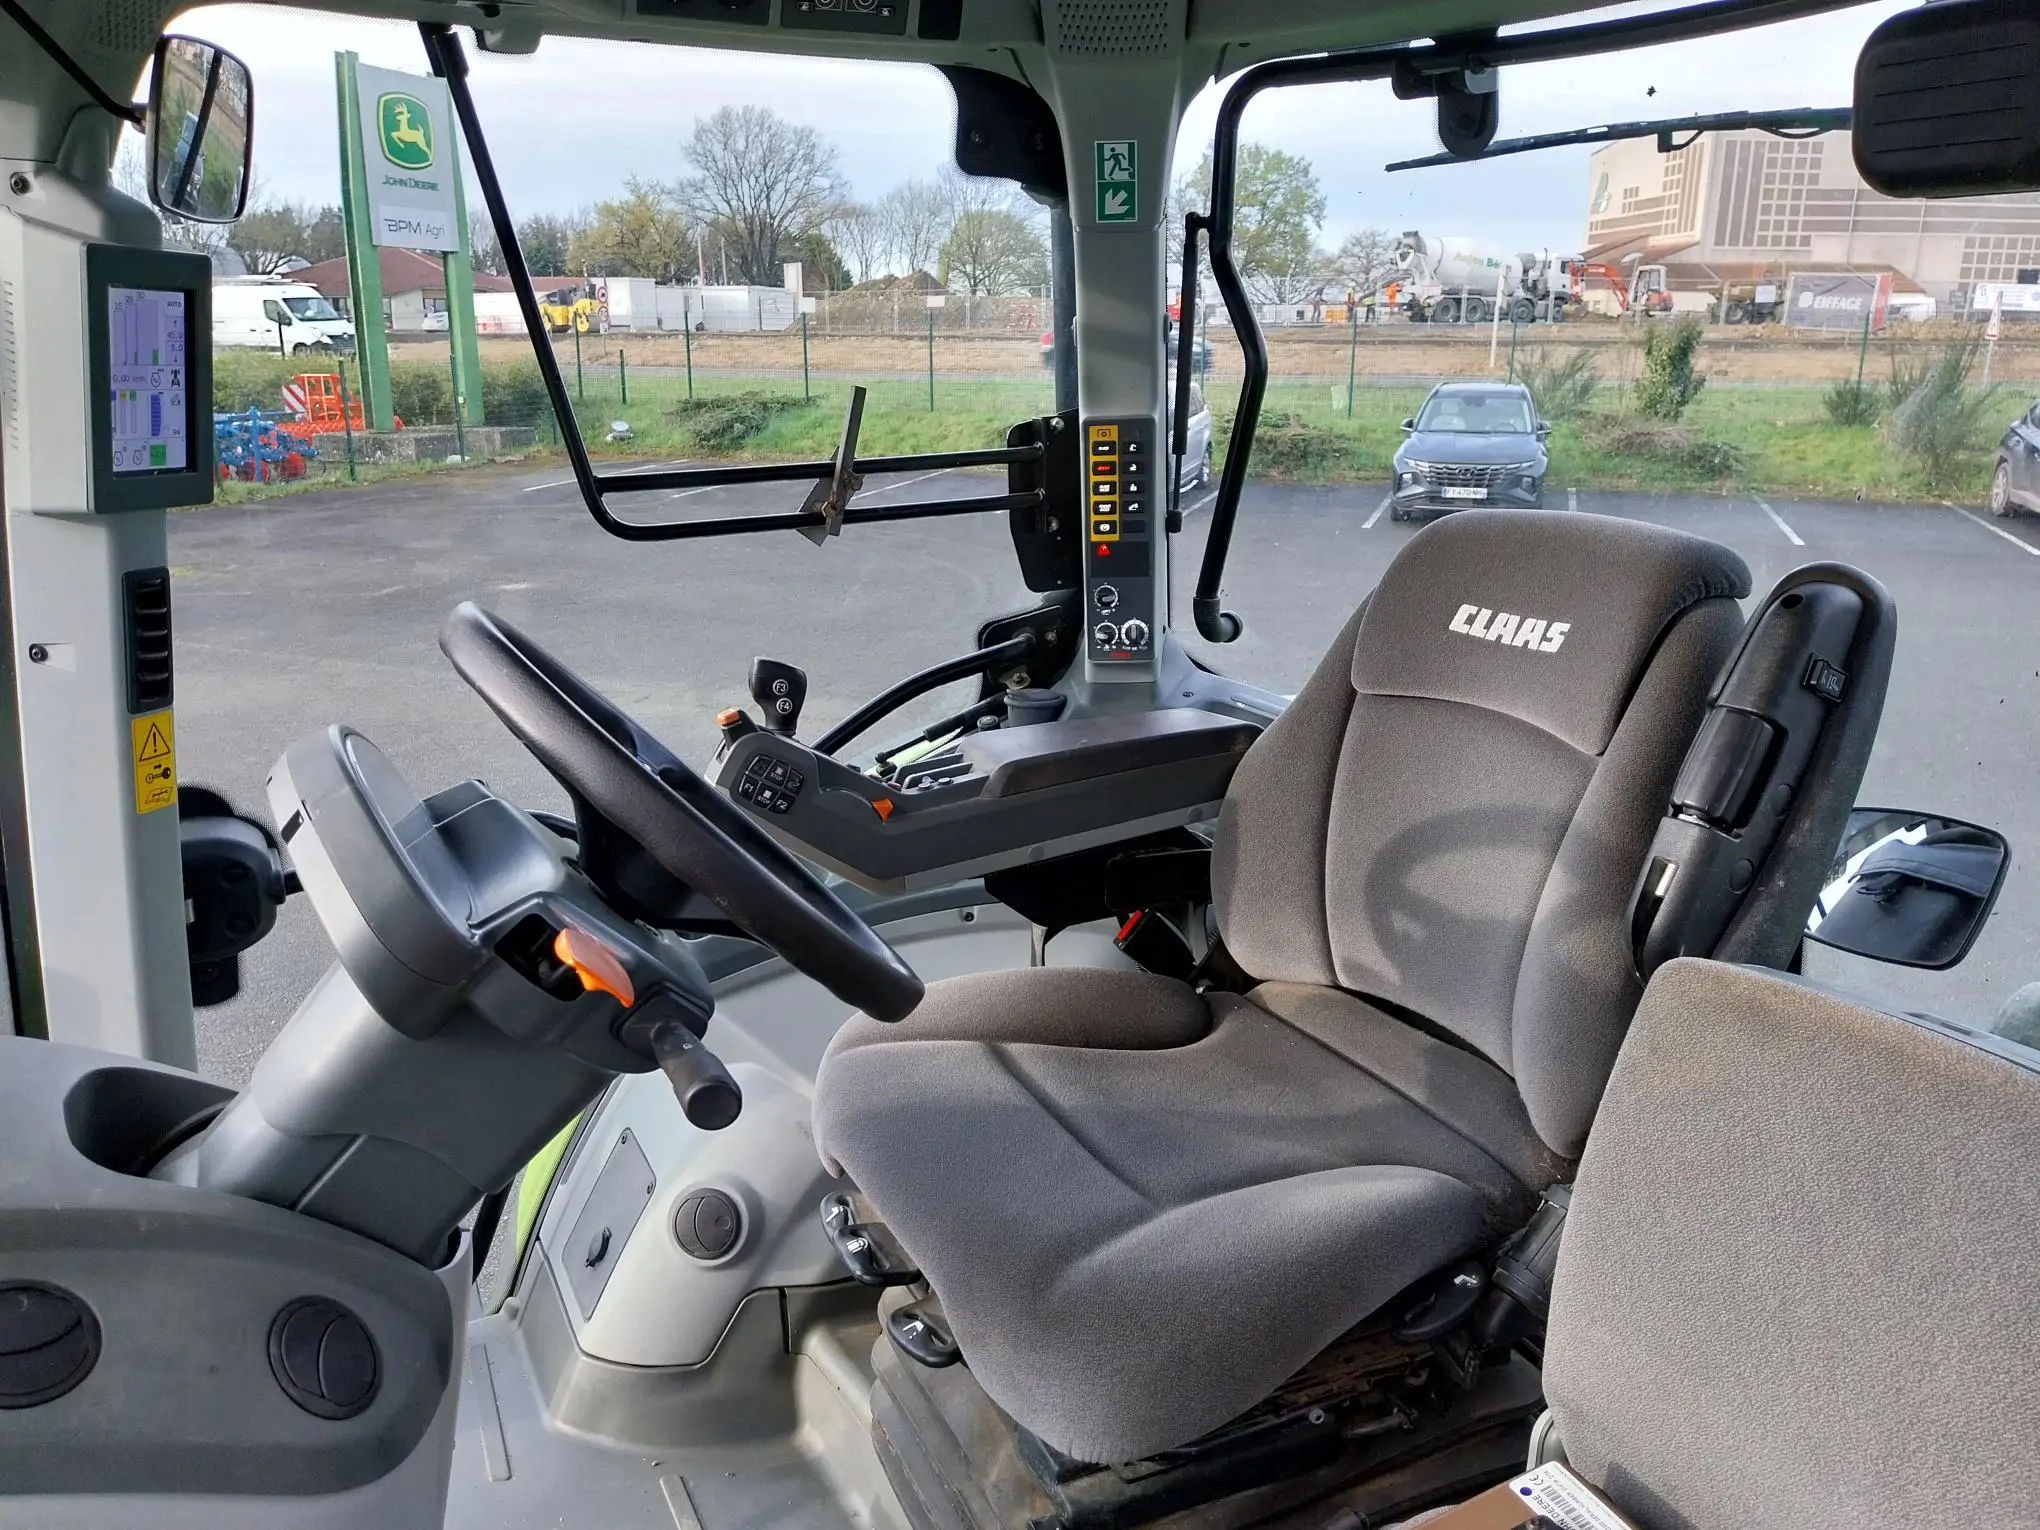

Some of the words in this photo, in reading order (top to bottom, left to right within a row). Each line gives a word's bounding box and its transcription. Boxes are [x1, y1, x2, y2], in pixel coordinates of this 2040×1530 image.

[382, 174, 408, 188] JOHN
[408, 177, 440, 192] DEERE
[383, 218, 422, 235] BPM
[425, 223, 445, 240] Agri
[1448, 603, 1571, 653] CLAAS
[776, 683, 786, 692] F3
[779, 701, 790, 710] F4
[770, 772, 783, 780] STOP
[744, 783, 754, 792] F1
[757, 795, 771, 804] STOP
[776, 799, 788, 810] F2
[1532, 1493, 1560, 1519] DEERE
